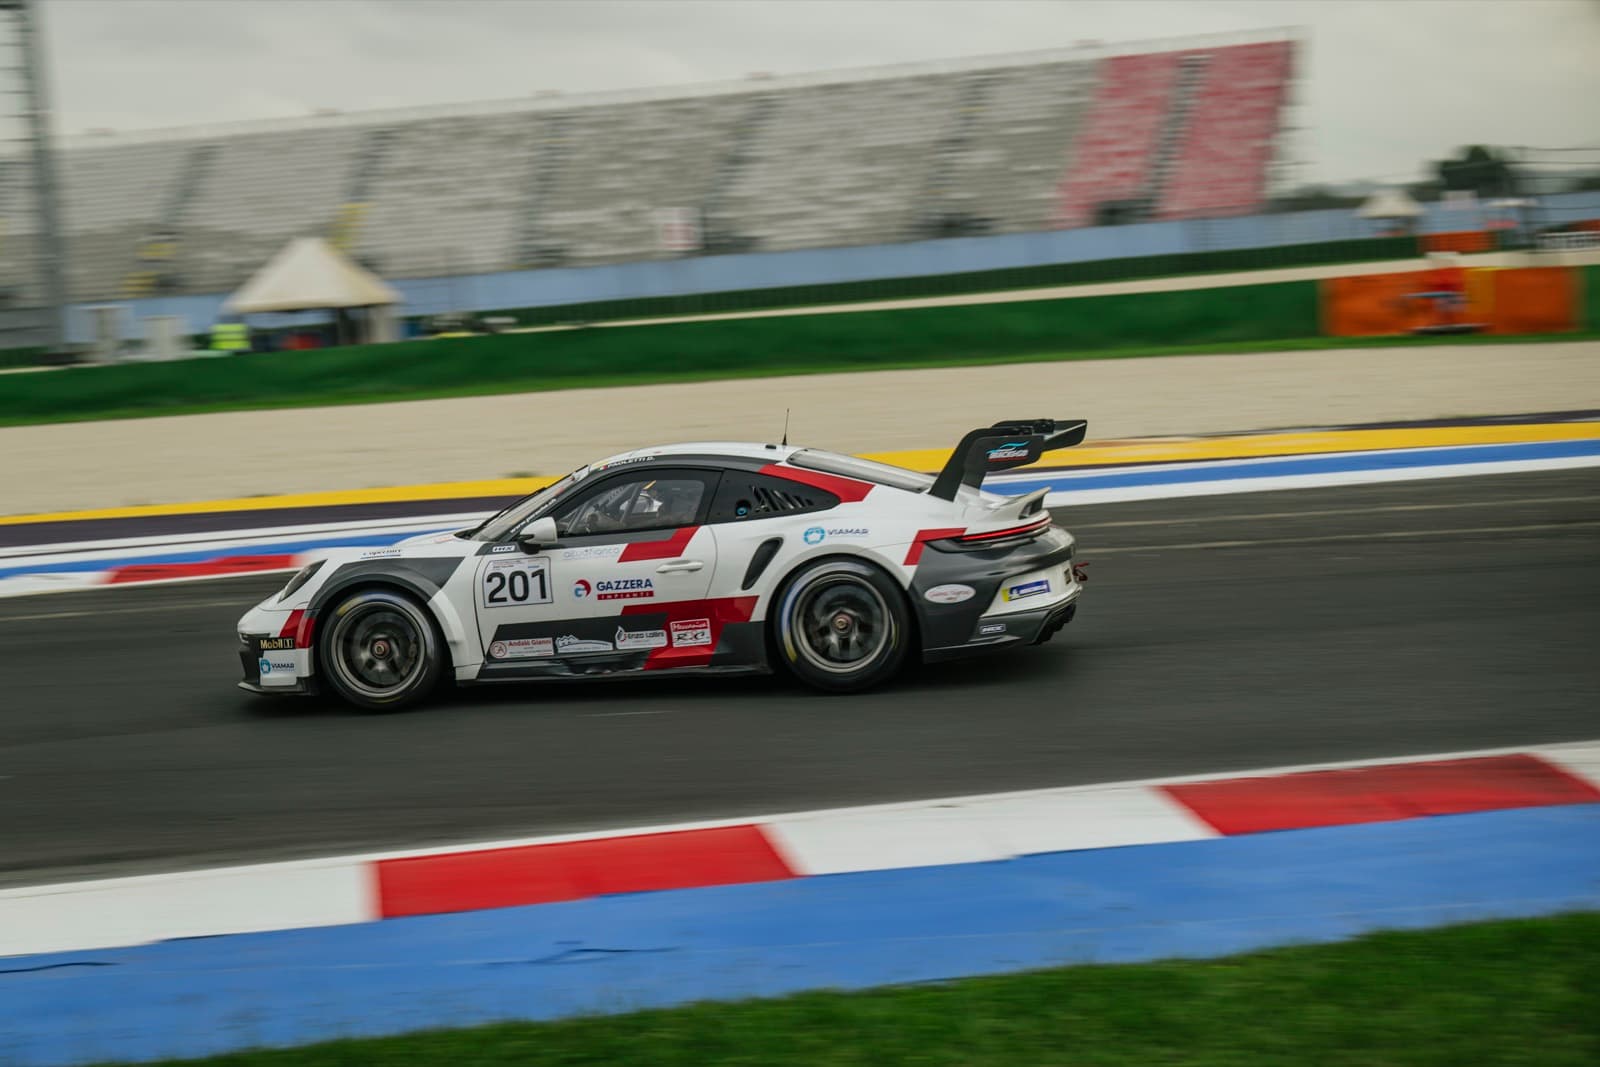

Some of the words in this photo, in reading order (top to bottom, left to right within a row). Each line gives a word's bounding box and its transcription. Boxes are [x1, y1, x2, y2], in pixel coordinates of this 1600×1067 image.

[486, 569, 547, 603] 201
[596, 578, 653, 591] GAZZERA
[260, 639, 283, 649] Mobil
